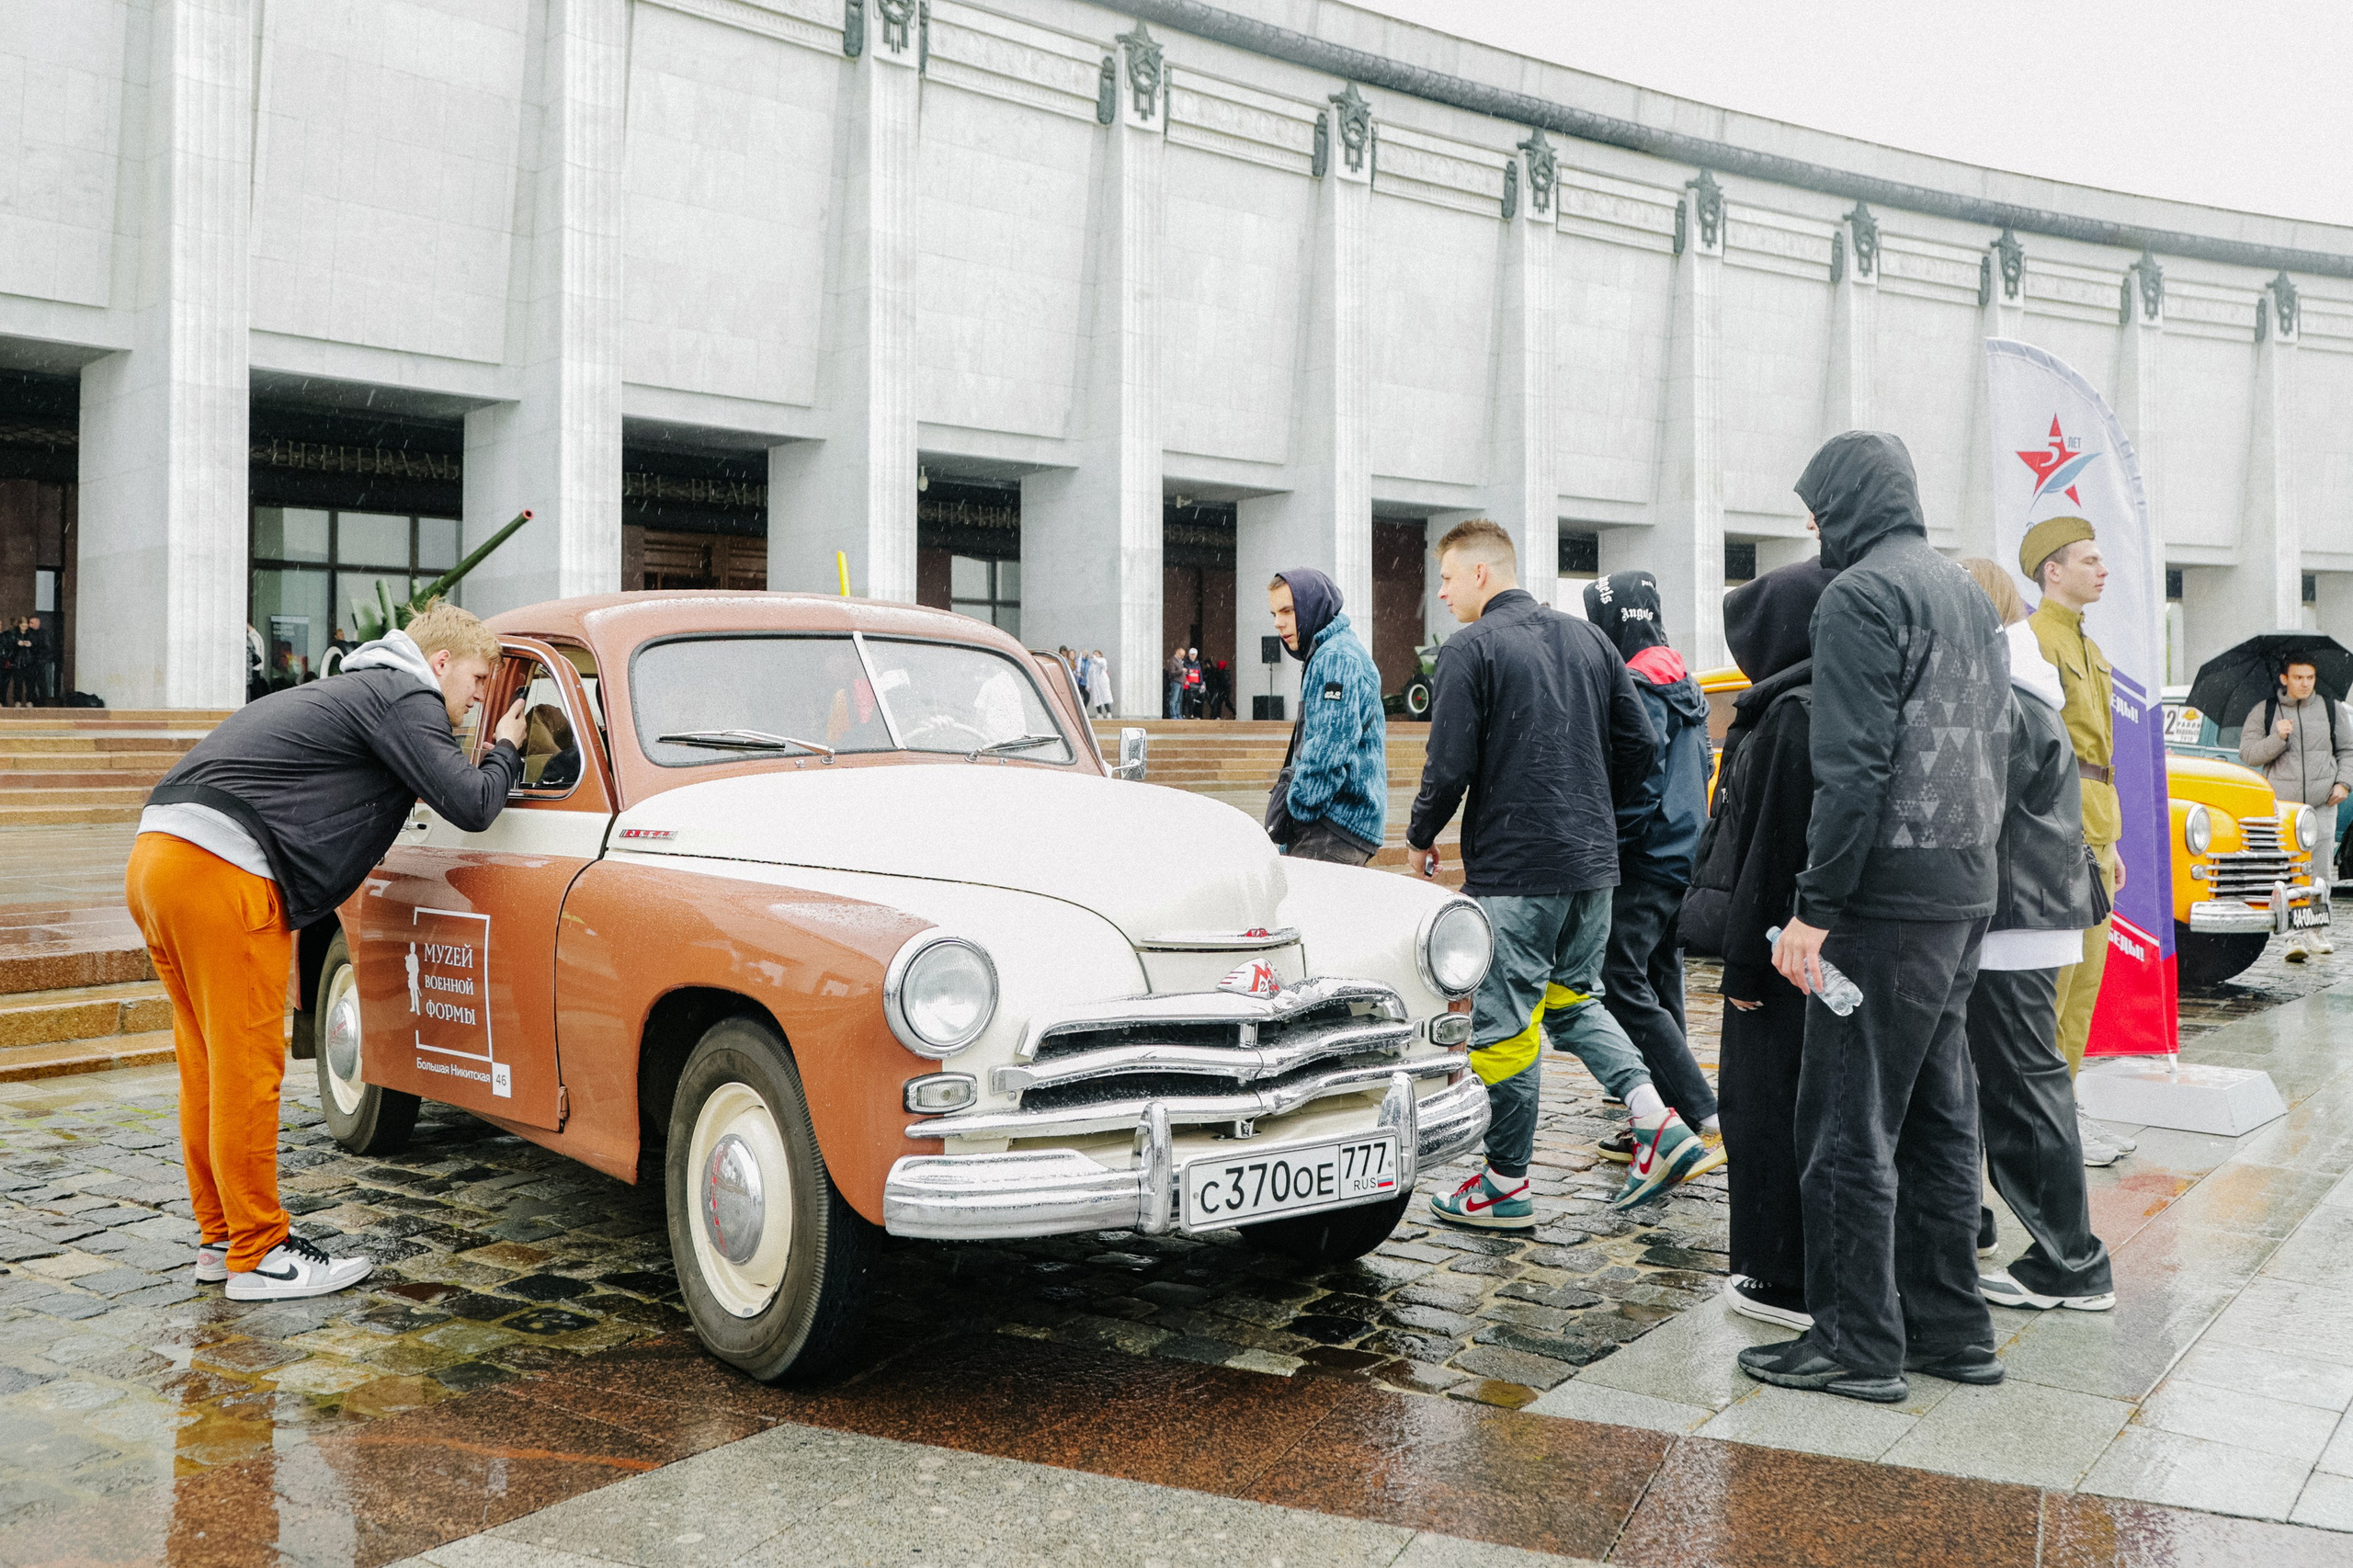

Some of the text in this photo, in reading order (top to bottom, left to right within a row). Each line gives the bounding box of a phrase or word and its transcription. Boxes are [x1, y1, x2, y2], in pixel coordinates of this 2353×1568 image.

[2067, 437, 2081, 449] ЛЕТ
[424, 974, 474, 995] ВОЕННОЙ
[426, 999, 477, 1026] ФОРМЫ
[416, 1057, 491, 1084] Большая Никитская
[495, 1073, 507, 1086] 46
[1342, 1142, 1387, 1179] 777
[1353, 1177, 1377, 1191] RUS
